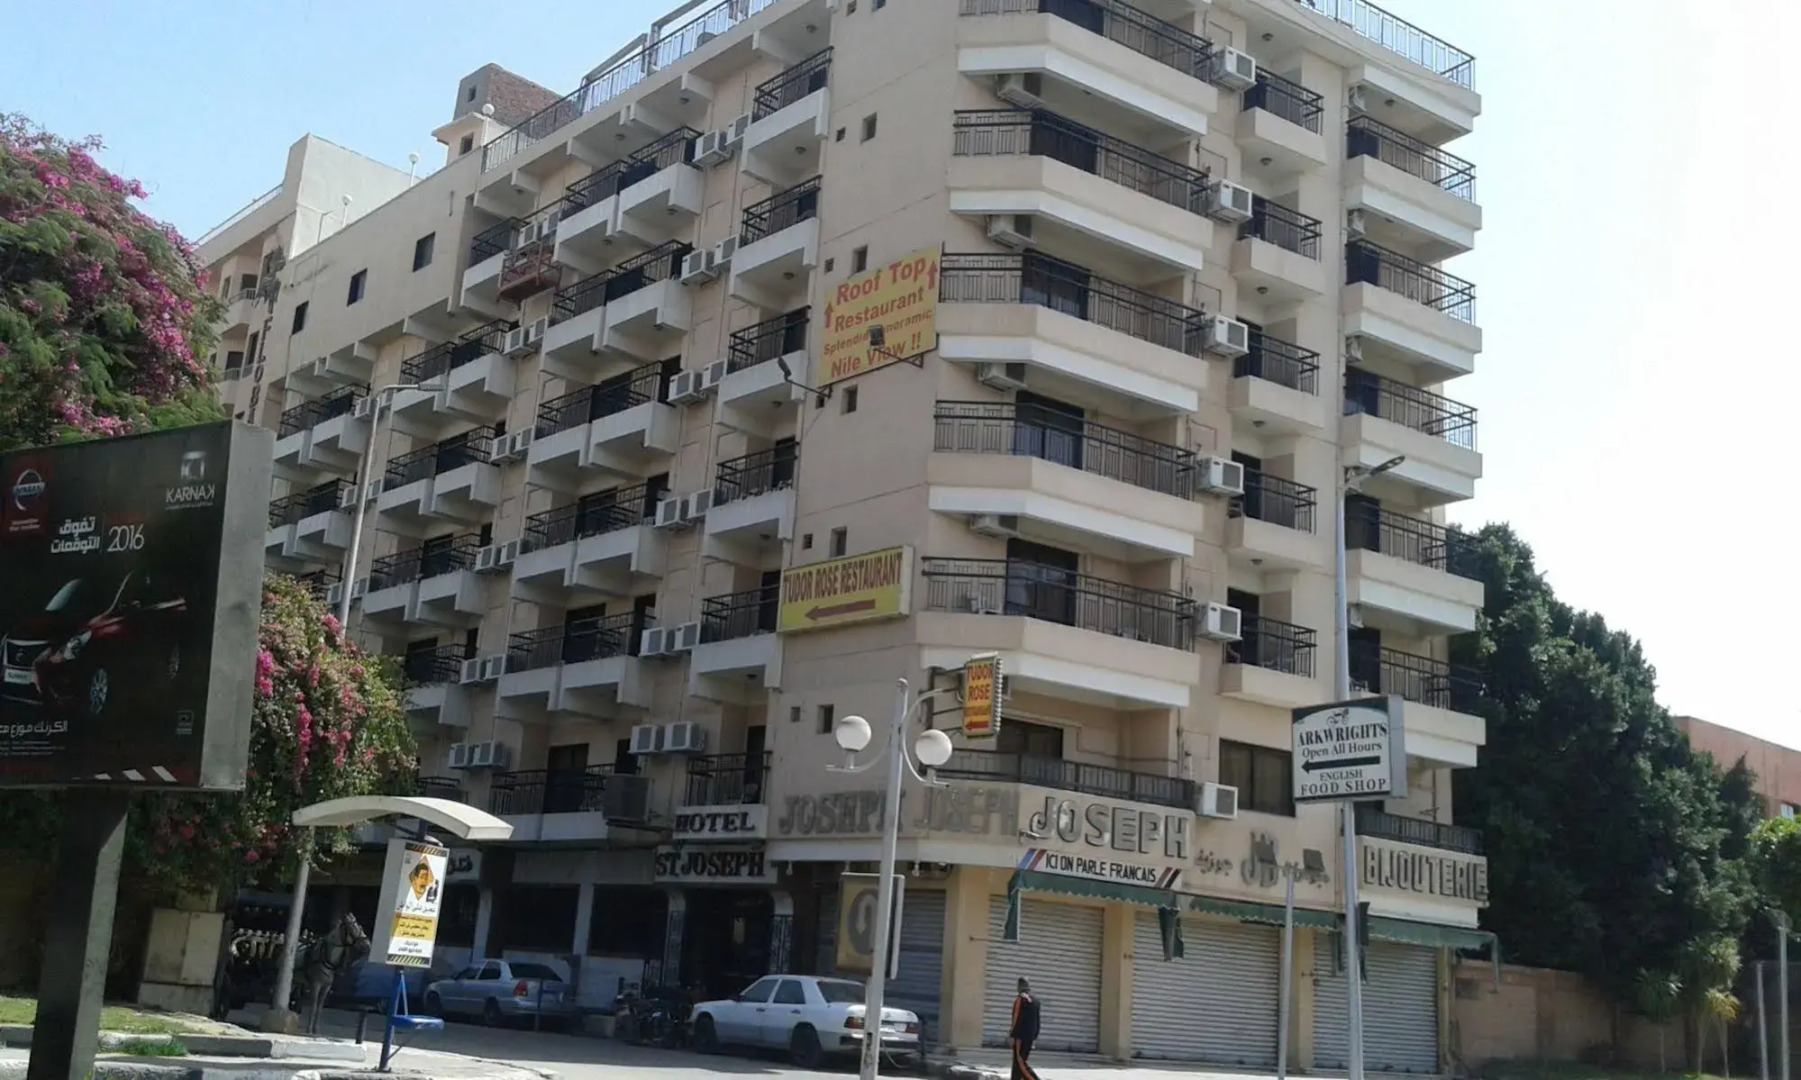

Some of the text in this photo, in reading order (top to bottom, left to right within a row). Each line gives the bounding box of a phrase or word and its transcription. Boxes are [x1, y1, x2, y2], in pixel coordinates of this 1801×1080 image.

[836, 256, 926, 306] Roof Top
[834, 286, 925, 333] Restaurant
[831, 355, 861, 378] Nile
[911, 332, 922, 350] !!
[166, 484, 215, 503] KARNAK
[59, 517, 97, 541] تفوق
[108, 524, 145, 551] 2016
[50, 537, 101, 554] التوقعات
[783, 552, 902, 603] TUDOR ROSE RESTAURANT
[968, 684, 991, 702] ROSE
[1299, 723, 1387, 747] ARKWRIGHTS
[1302, 742, 1383, 760] Open All Hours
[1301, 778, 1386, 796] FOOD SHOP
[1320, 769, 1363, 782] ENGLISH
[675, 812, 756, 833] HOTEL
[1029, 796, 1188, 859] JOSEPH
[1045, 853, 1156, 882] ICI ON PARLE FRANCAIS
[1363, 845, 1489, 902] BIJOUTERIE
